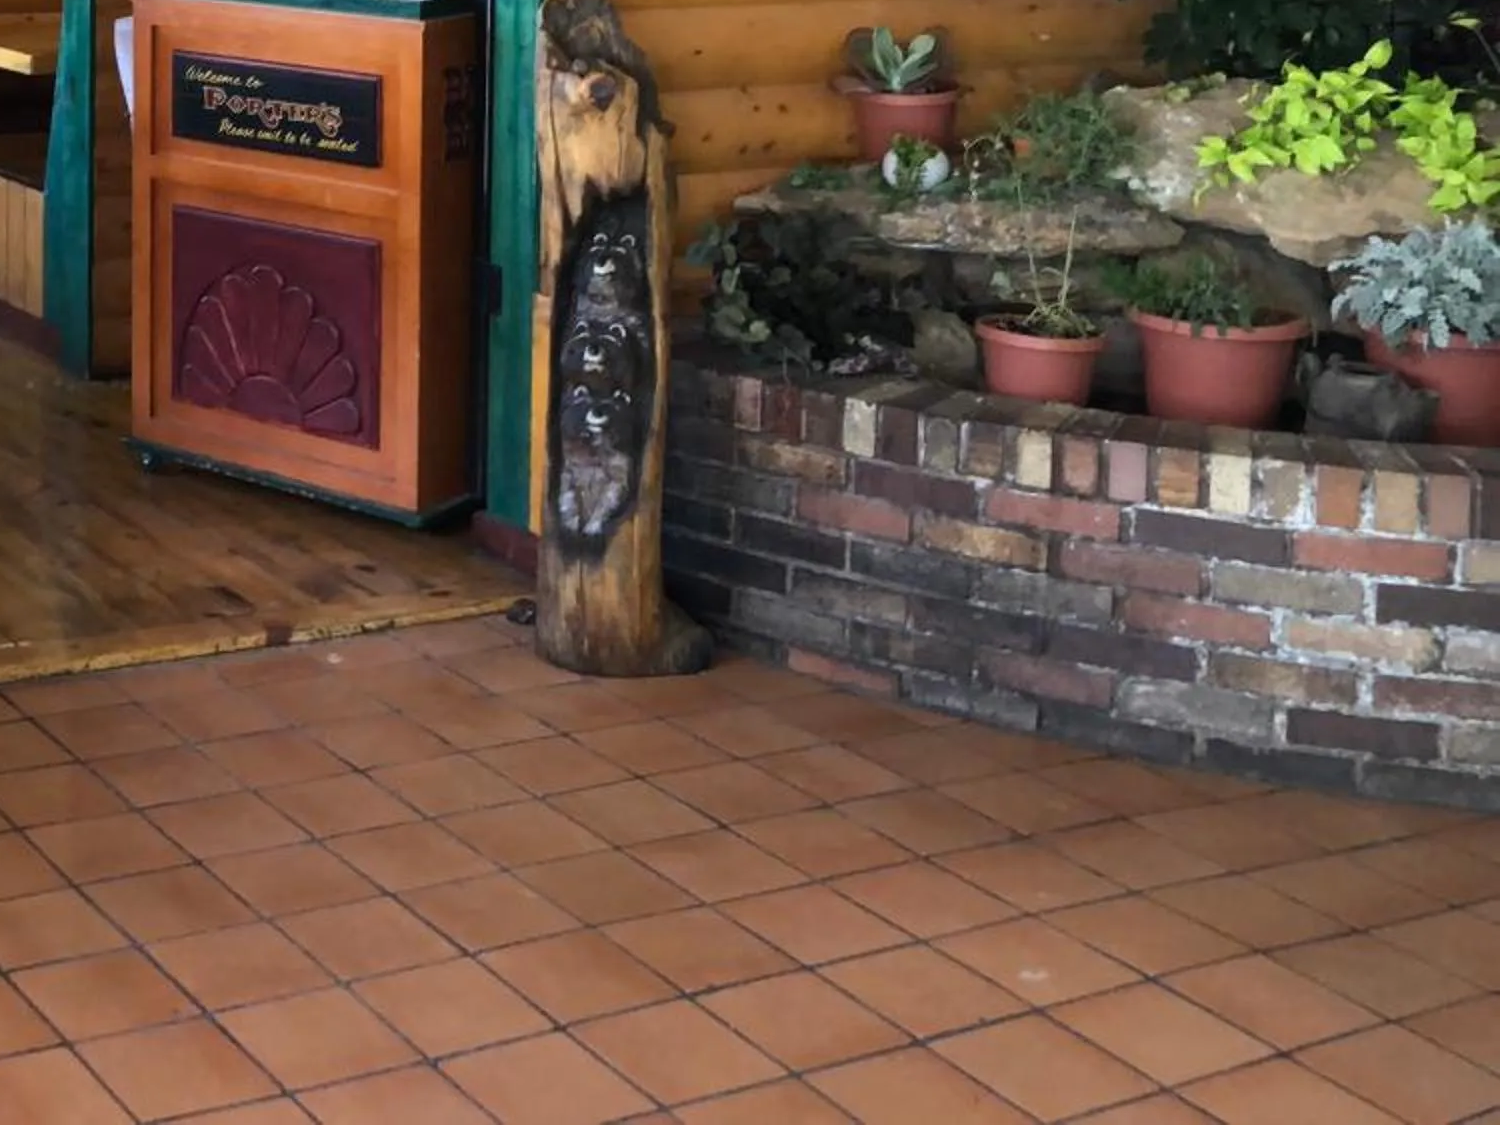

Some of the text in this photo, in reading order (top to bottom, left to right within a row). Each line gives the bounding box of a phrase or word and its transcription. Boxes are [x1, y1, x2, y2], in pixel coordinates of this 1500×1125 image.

[185, 64, 263, 89] Welcome to
[218, 118, 359, 153] Please wait to be seated
